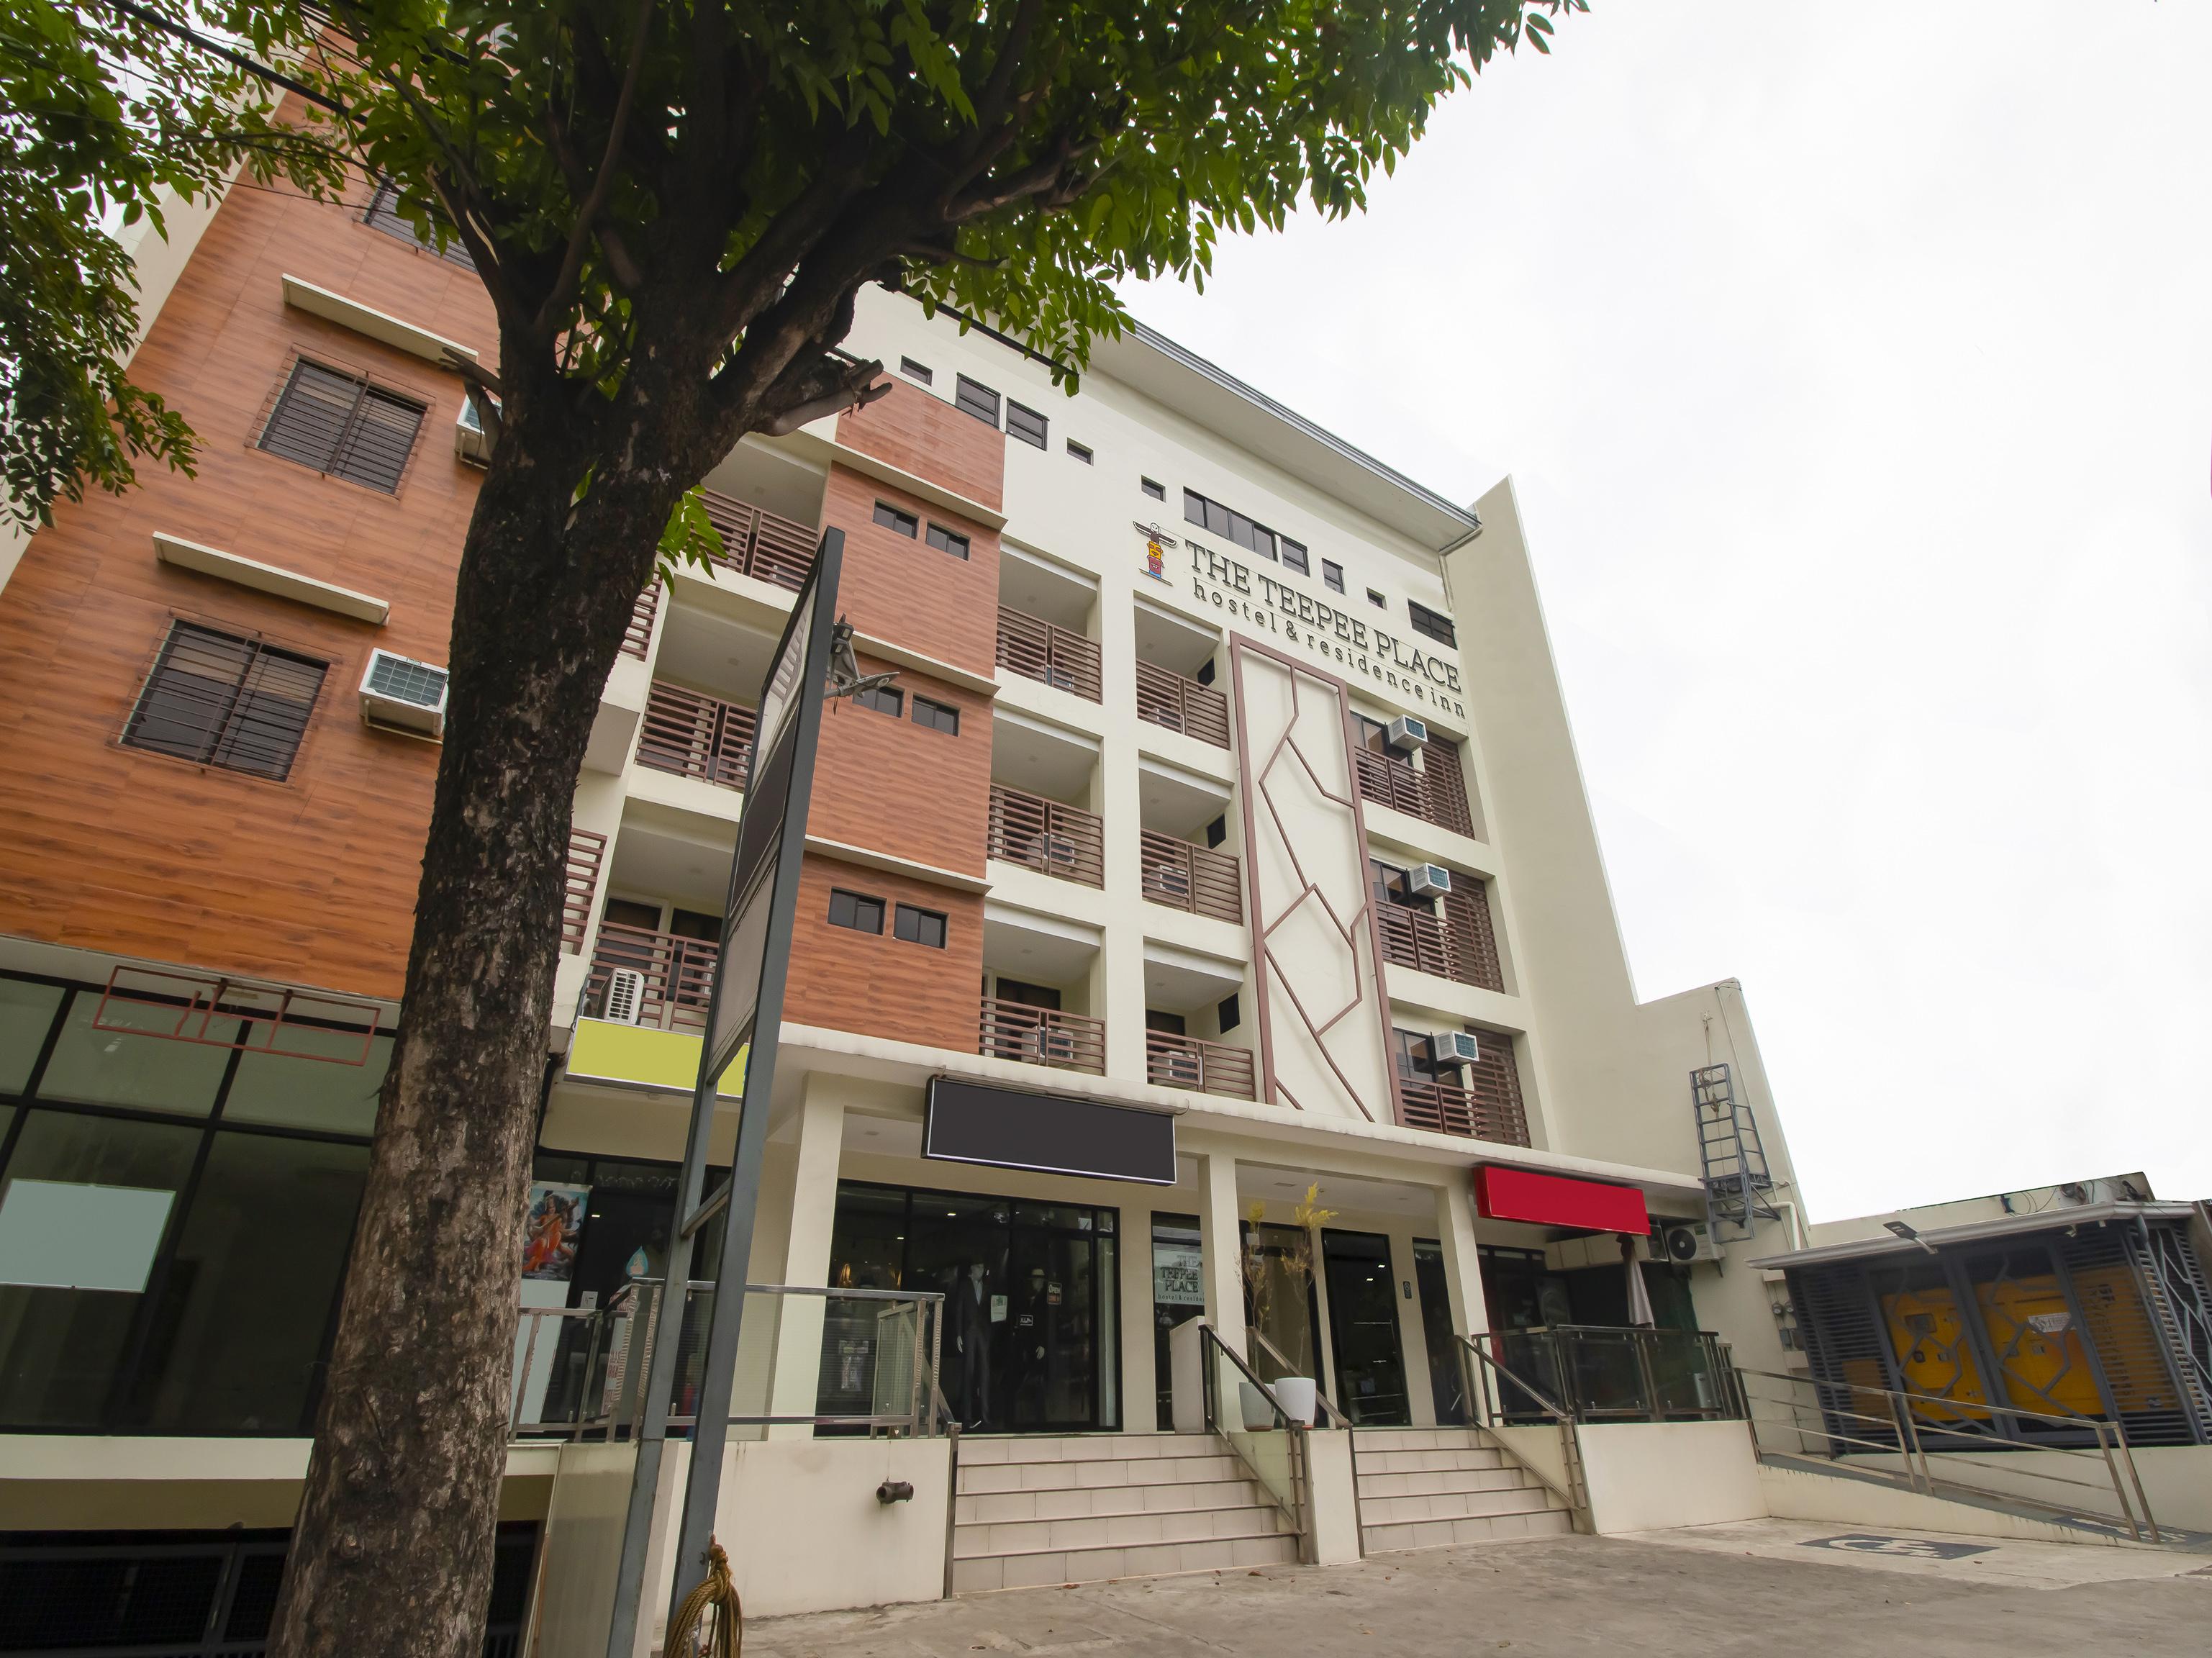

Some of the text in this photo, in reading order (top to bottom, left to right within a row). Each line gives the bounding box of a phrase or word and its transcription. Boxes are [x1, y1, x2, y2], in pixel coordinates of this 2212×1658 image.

[1185, 539, 1461, 694] THE TEEPEE PLACE
[1193, 576, 1465, 720] hostel & residence inn
[1177, 1255, 1198, 1267] THE
[1161, 1267, 1198, 1280] TEEPEE
[1165, 1279, 1198, 1292] PLACE
